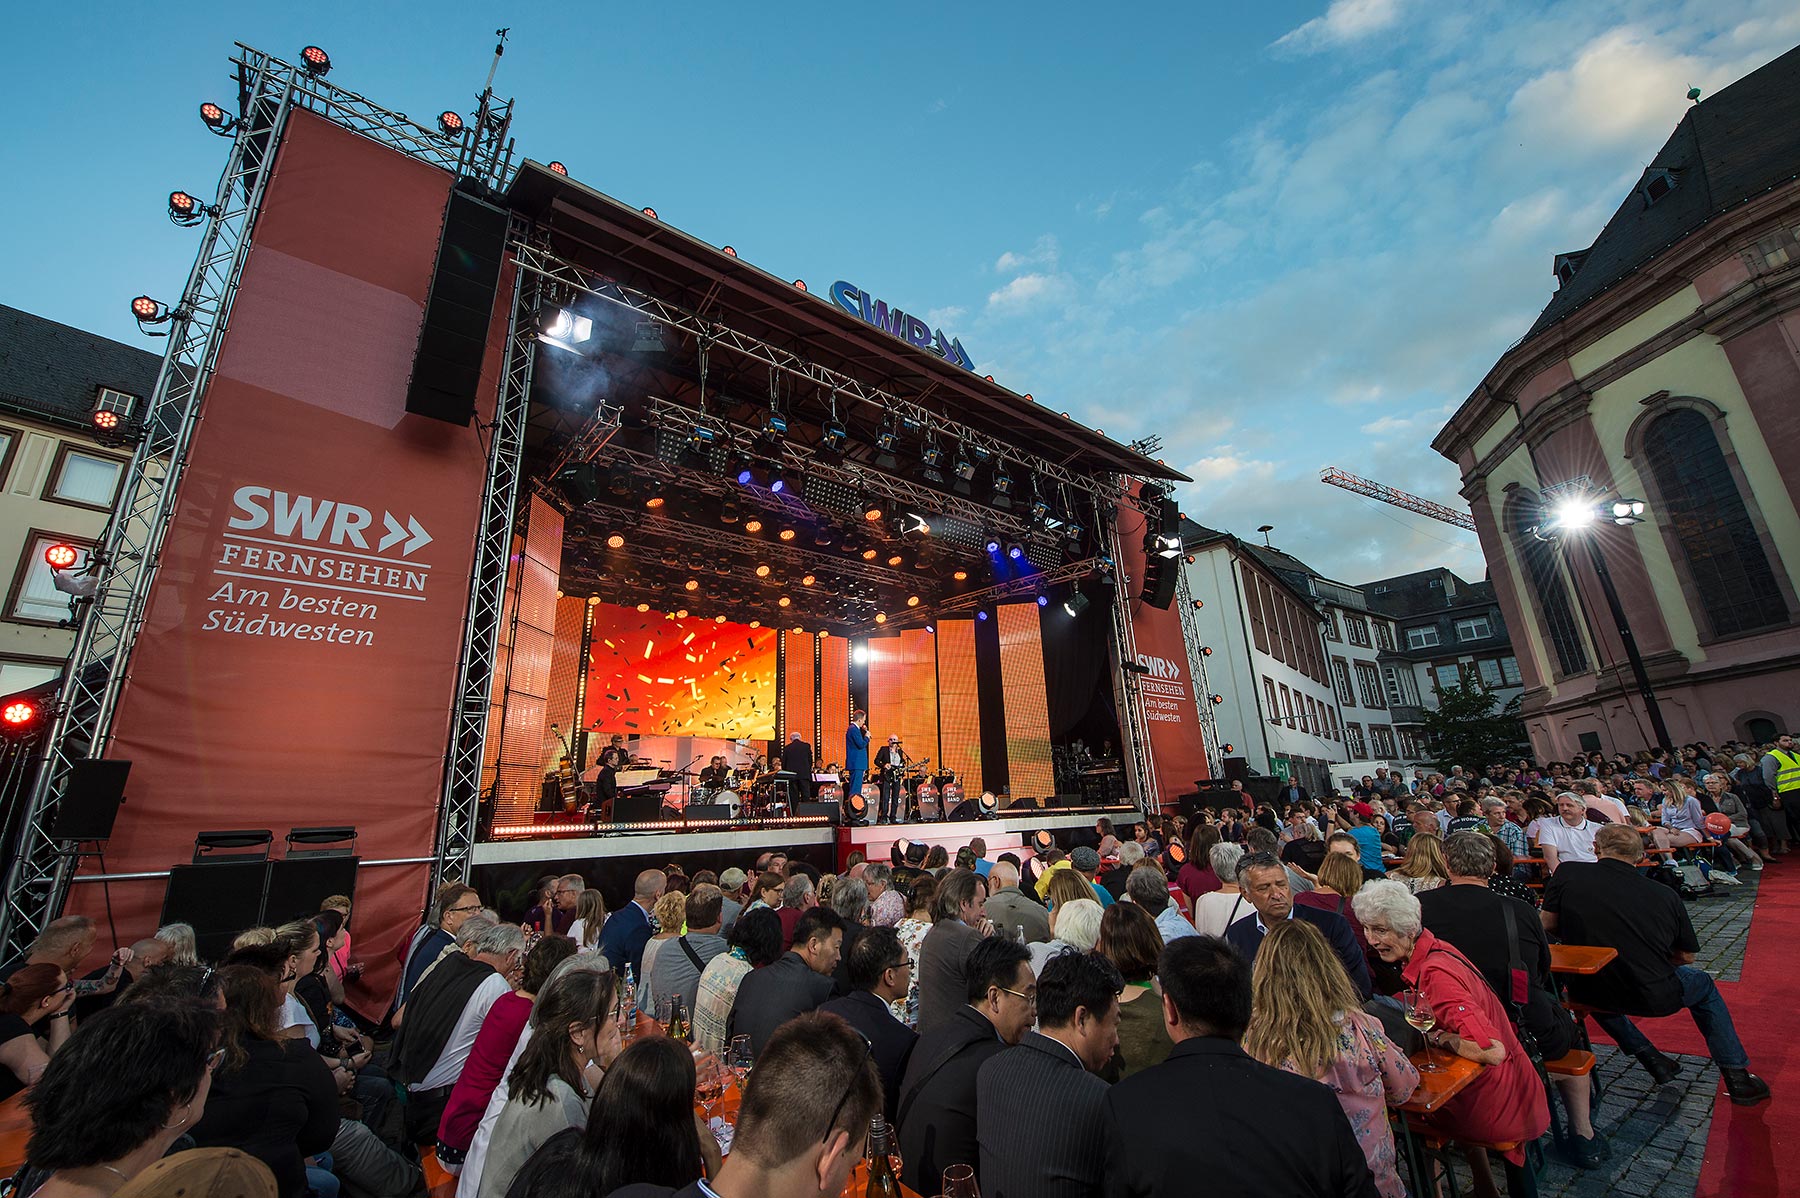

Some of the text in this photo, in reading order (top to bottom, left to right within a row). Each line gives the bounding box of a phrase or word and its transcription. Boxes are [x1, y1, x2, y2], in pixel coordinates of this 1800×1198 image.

[829, 280, 932, 350] SWR
[227, 485, 373, 550] SWR
[218, 543, 428, 591] FERNSEHEN
[207, 581, 378, 620] Am besten
[201, 609, 375, 646] Südwesten
[1142, 680, 1185, 696] FERNSEHEN
[1145, 698, 1179, 711] Am besten
[1146, 709, 1181, 723] Südwesten
